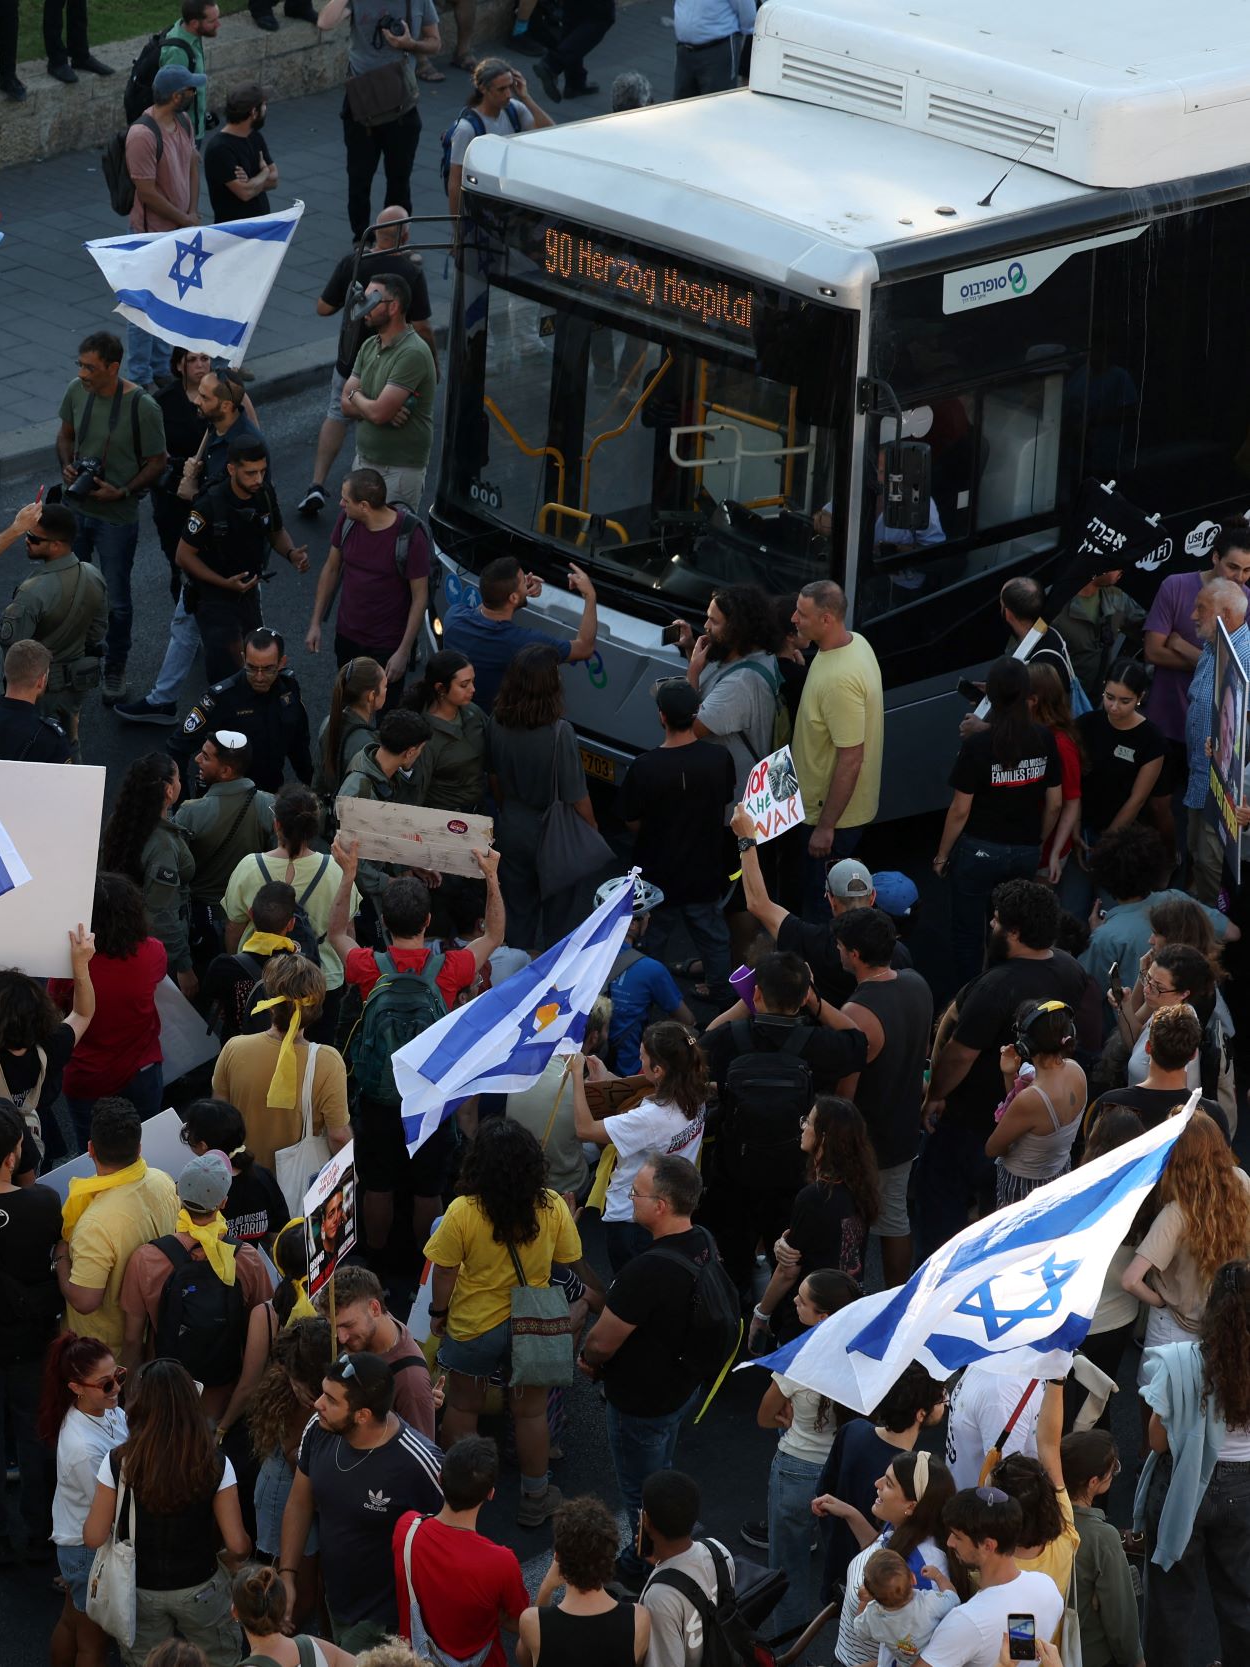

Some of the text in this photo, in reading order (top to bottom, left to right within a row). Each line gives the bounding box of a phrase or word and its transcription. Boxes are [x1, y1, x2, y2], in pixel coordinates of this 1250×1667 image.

[545, 228, 753, 328] 90 Herzog Hospital
[960, 276, 1007, 298] סופרבוס
[1188, 531, 1204, 544] USB
[991, 766, 1026, 784] FAMILIES
[745, 791, 772, 816] THE
[239, 1219, 269, 1238] FORUM
[363, 1502, 388, 1513] adidas
